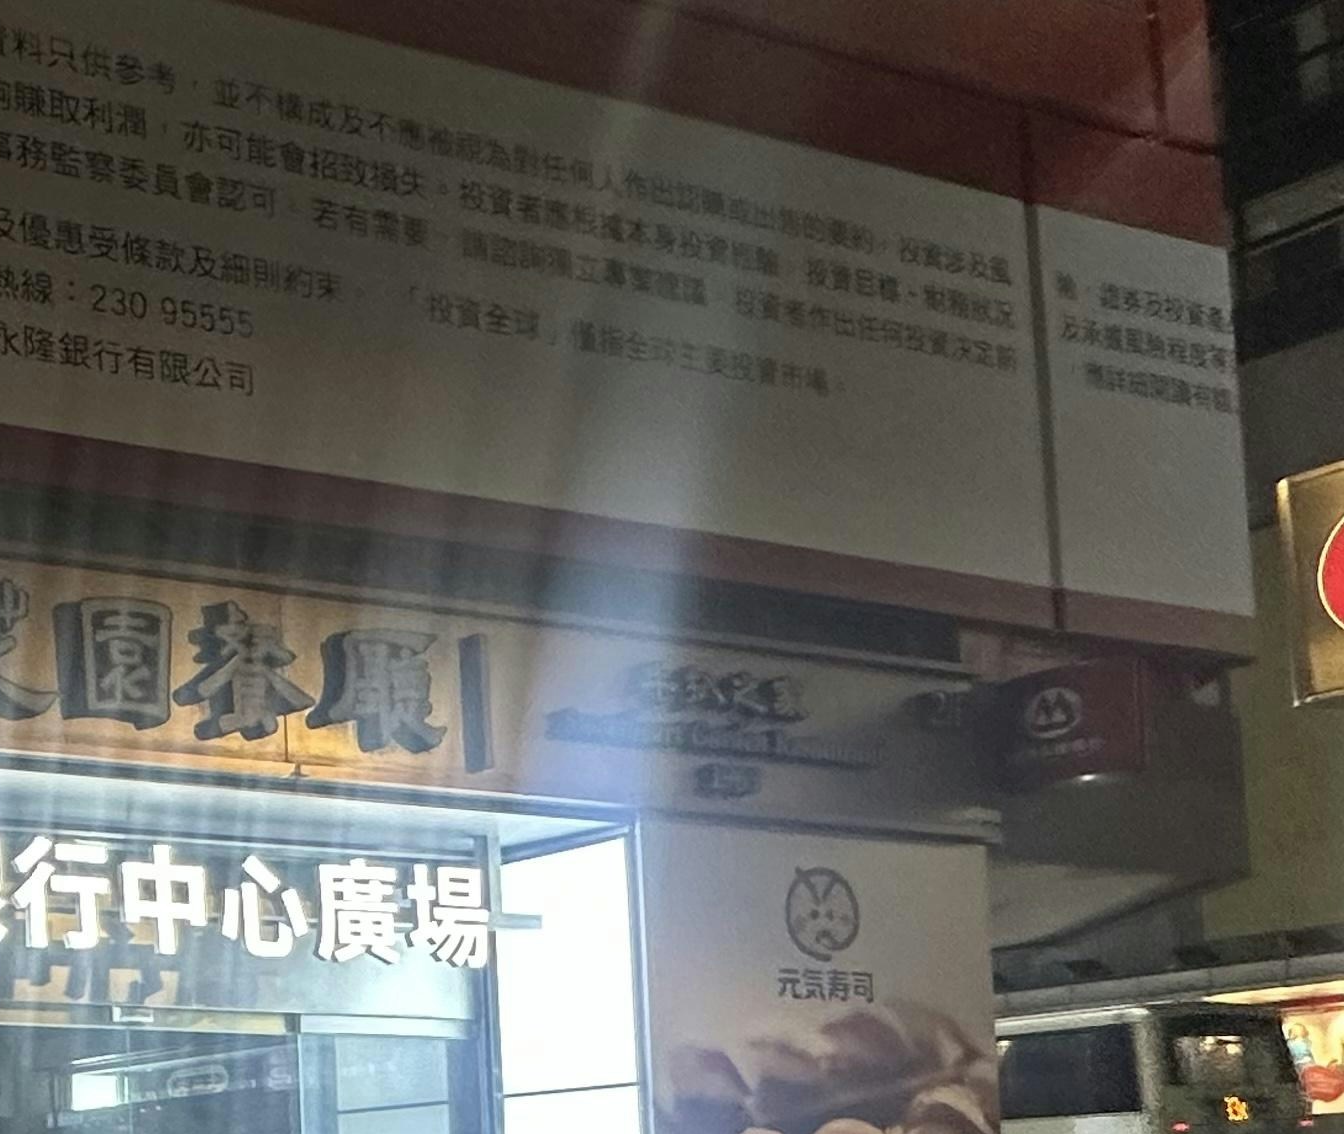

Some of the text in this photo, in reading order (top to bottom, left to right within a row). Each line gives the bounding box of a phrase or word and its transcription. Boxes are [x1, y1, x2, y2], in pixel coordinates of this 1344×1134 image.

[160, 297, 254, 338] 95555
[778, 967, 874, 1003] 元気寿司
